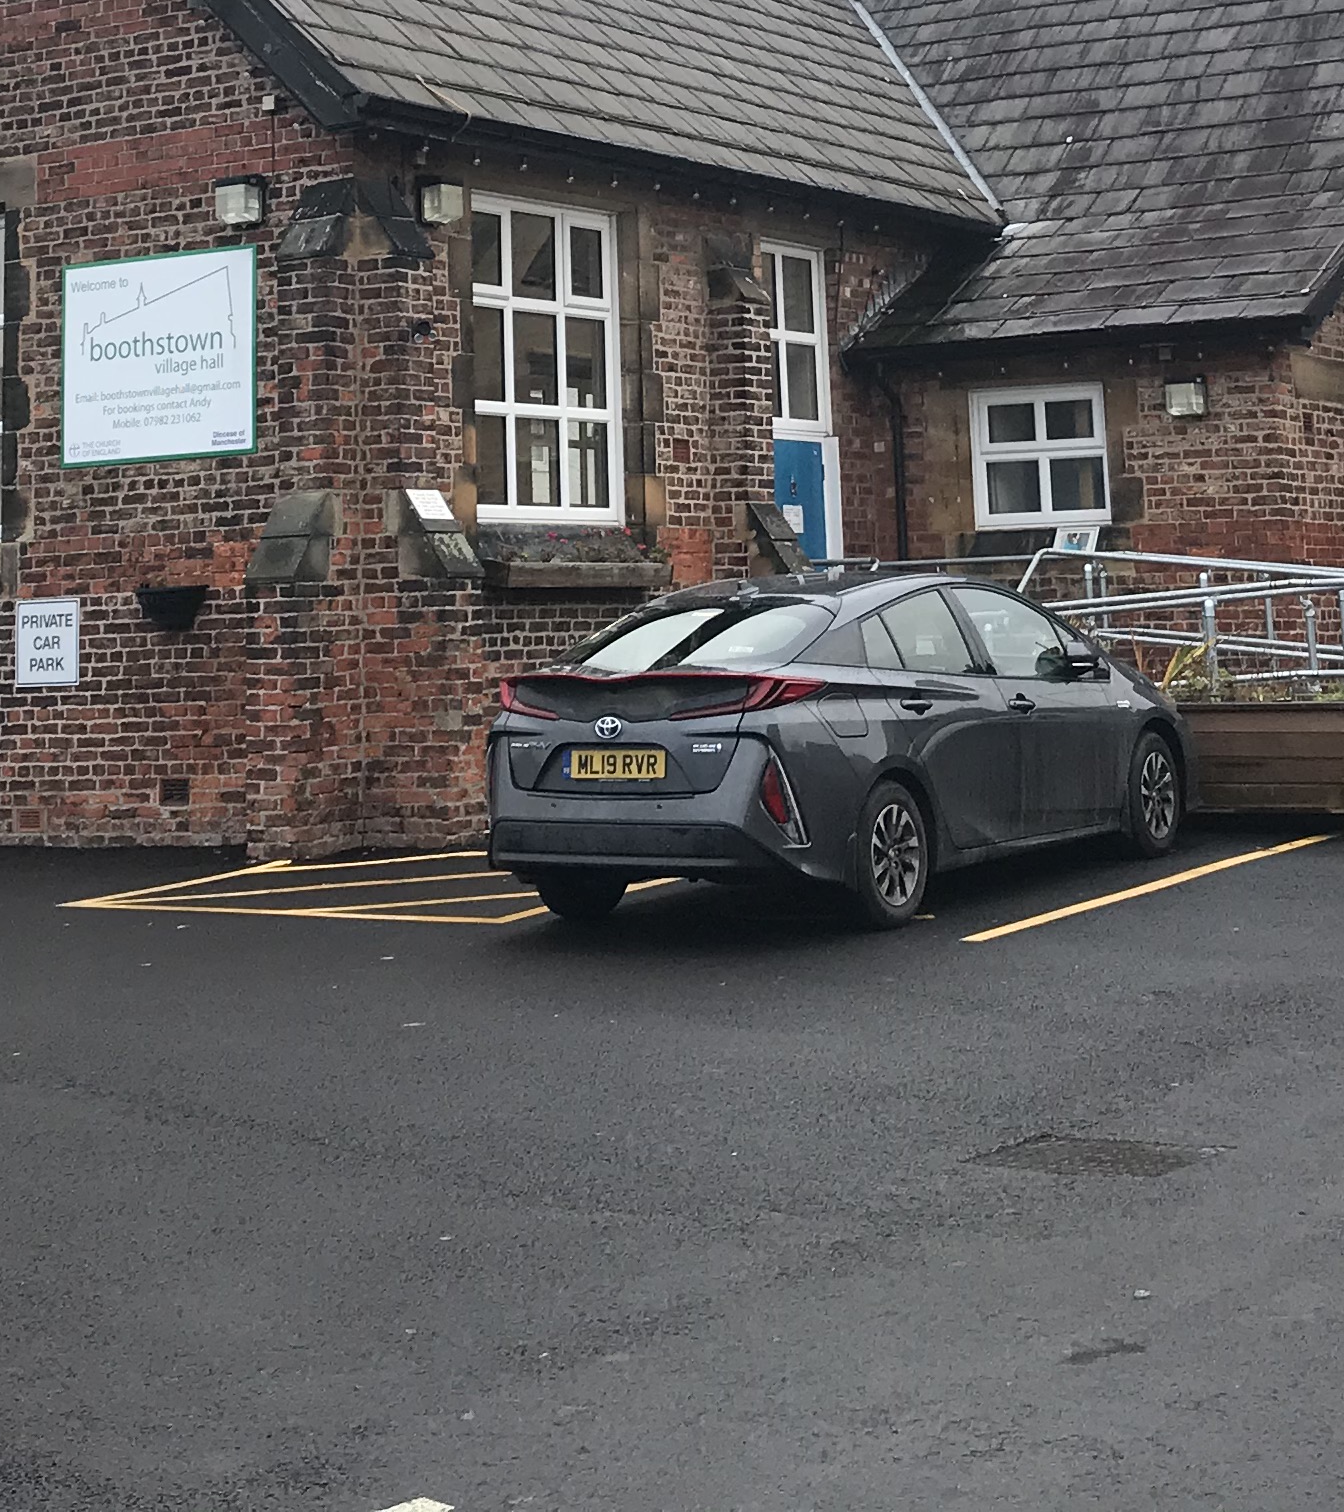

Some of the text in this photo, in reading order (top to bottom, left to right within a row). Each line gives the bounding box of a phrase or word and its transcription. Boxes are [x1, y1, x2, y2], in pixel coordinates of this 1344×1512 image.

[70, 277, 129, 294] Welcome to
[90, 331, 223, 362] boothstown
[154, 353, 224, 376] village hall
[102, 396, 212, 416] For bookings contact Andy
[170, 412, 201, 425] 231062
[212, 429, 246, 438] Diocese of
[211, 438, 247, 446] Manchester
[21, 613, 73, 629] PRIVATE
[33, 635, 61, 650] CAR
[29, 656, 65, 672] PARK
[577, 754, 658, 775] ML19 RVR
